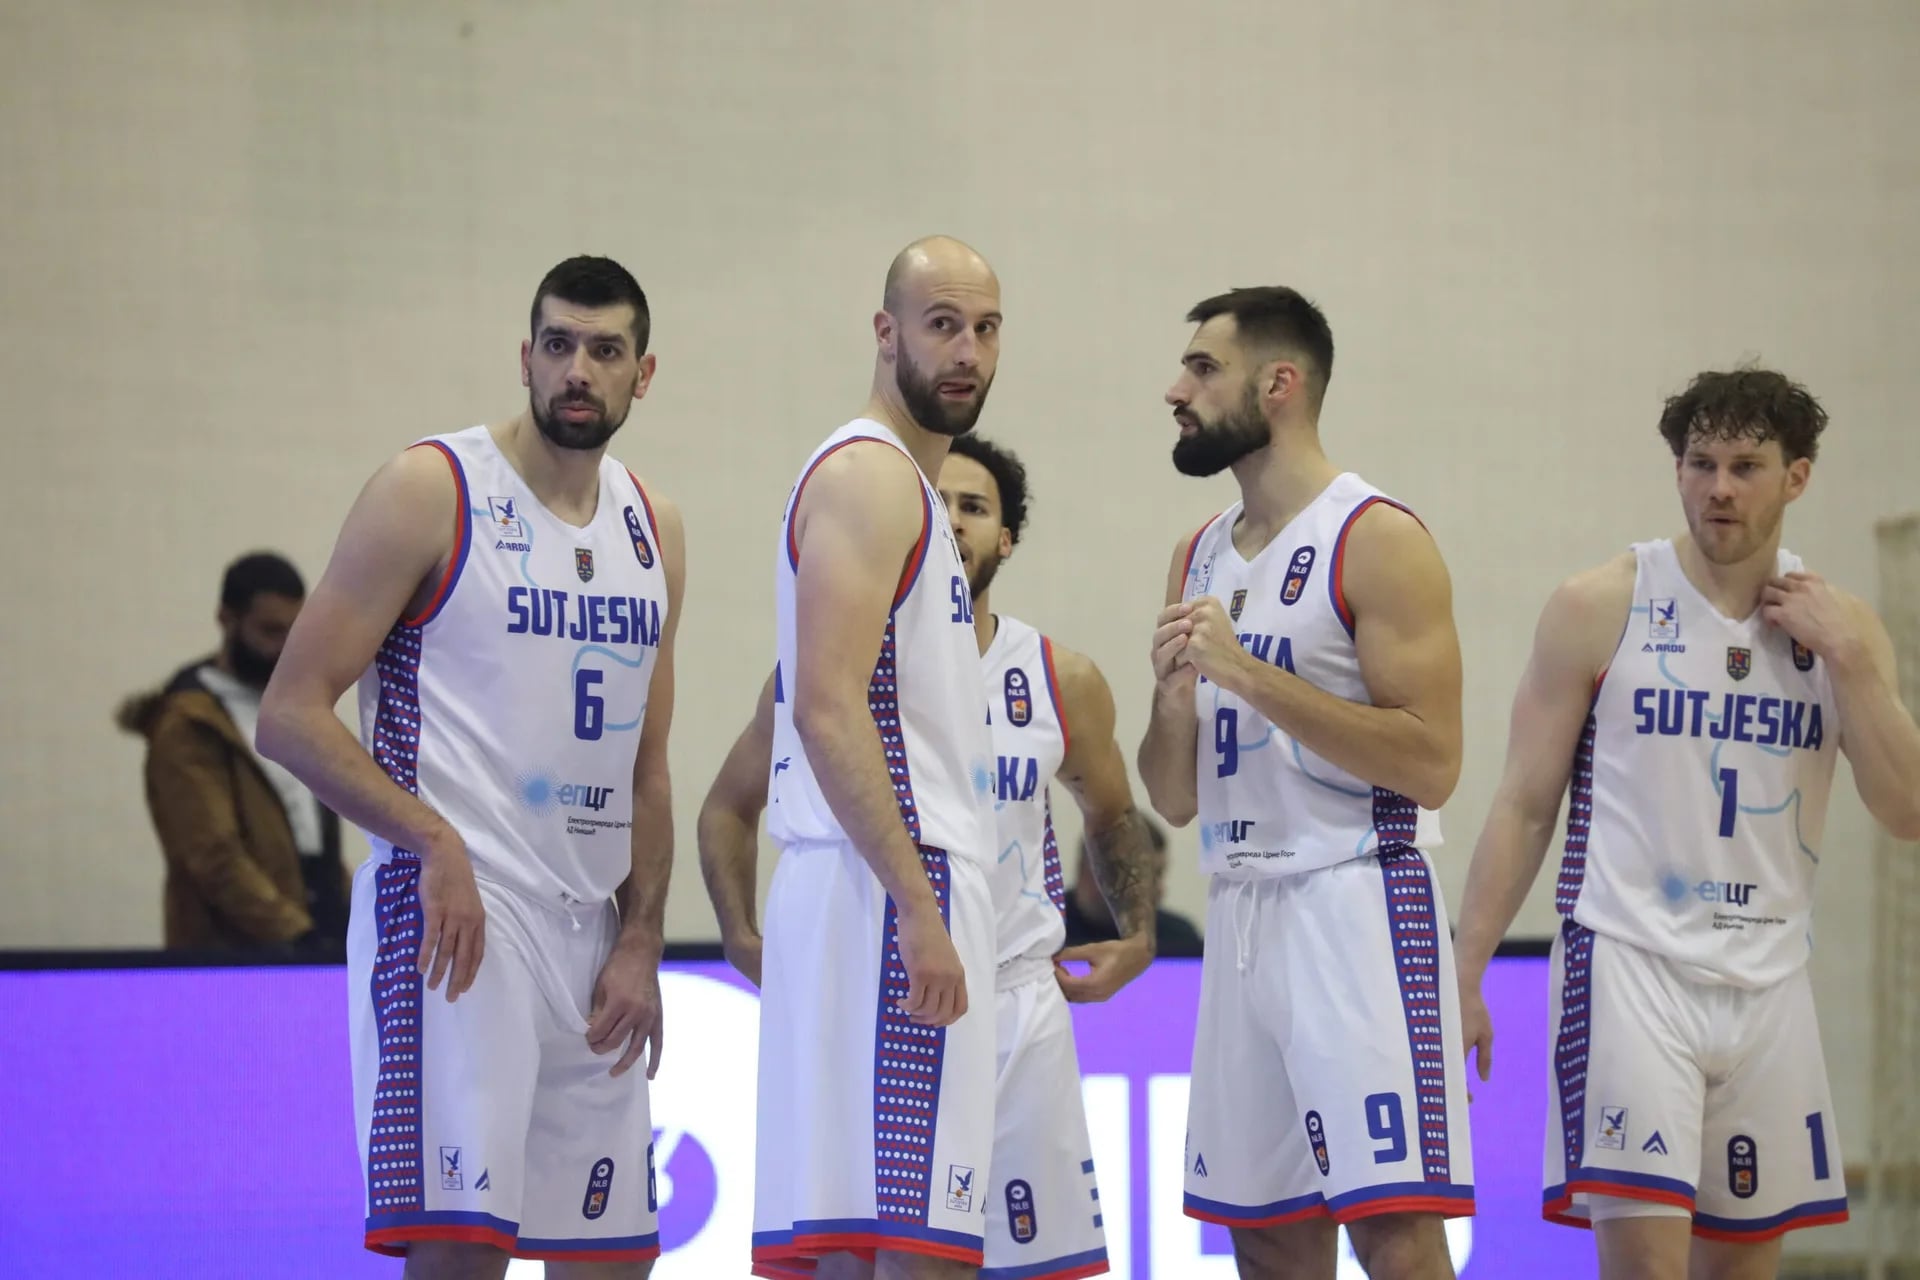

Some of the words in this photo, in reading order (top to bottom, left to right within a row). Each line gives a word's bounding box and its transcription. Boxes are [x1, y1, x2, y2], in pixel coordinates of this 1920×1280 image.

[1291, 565, 1308, 574] NLB
[507, 586, 660, 648] SUTJESKA
[574, 669, 604, 741] 6
[1008, 688, 1026, 696] NLB
[1633, 688, 1823, 751] SUTJESKA
[1215, 707, 1238, 778] 9
[1719, 767, 1738, 838] 1
[1364, 1092, 1407, 1164] 9
[1805, 1111, 1830, 1181] 1
[591, 1179, 608, 1188] NLB
[1733, 1156, 1752, 1166] NLB
[1011, 1201, 1030, 1210] NLB
